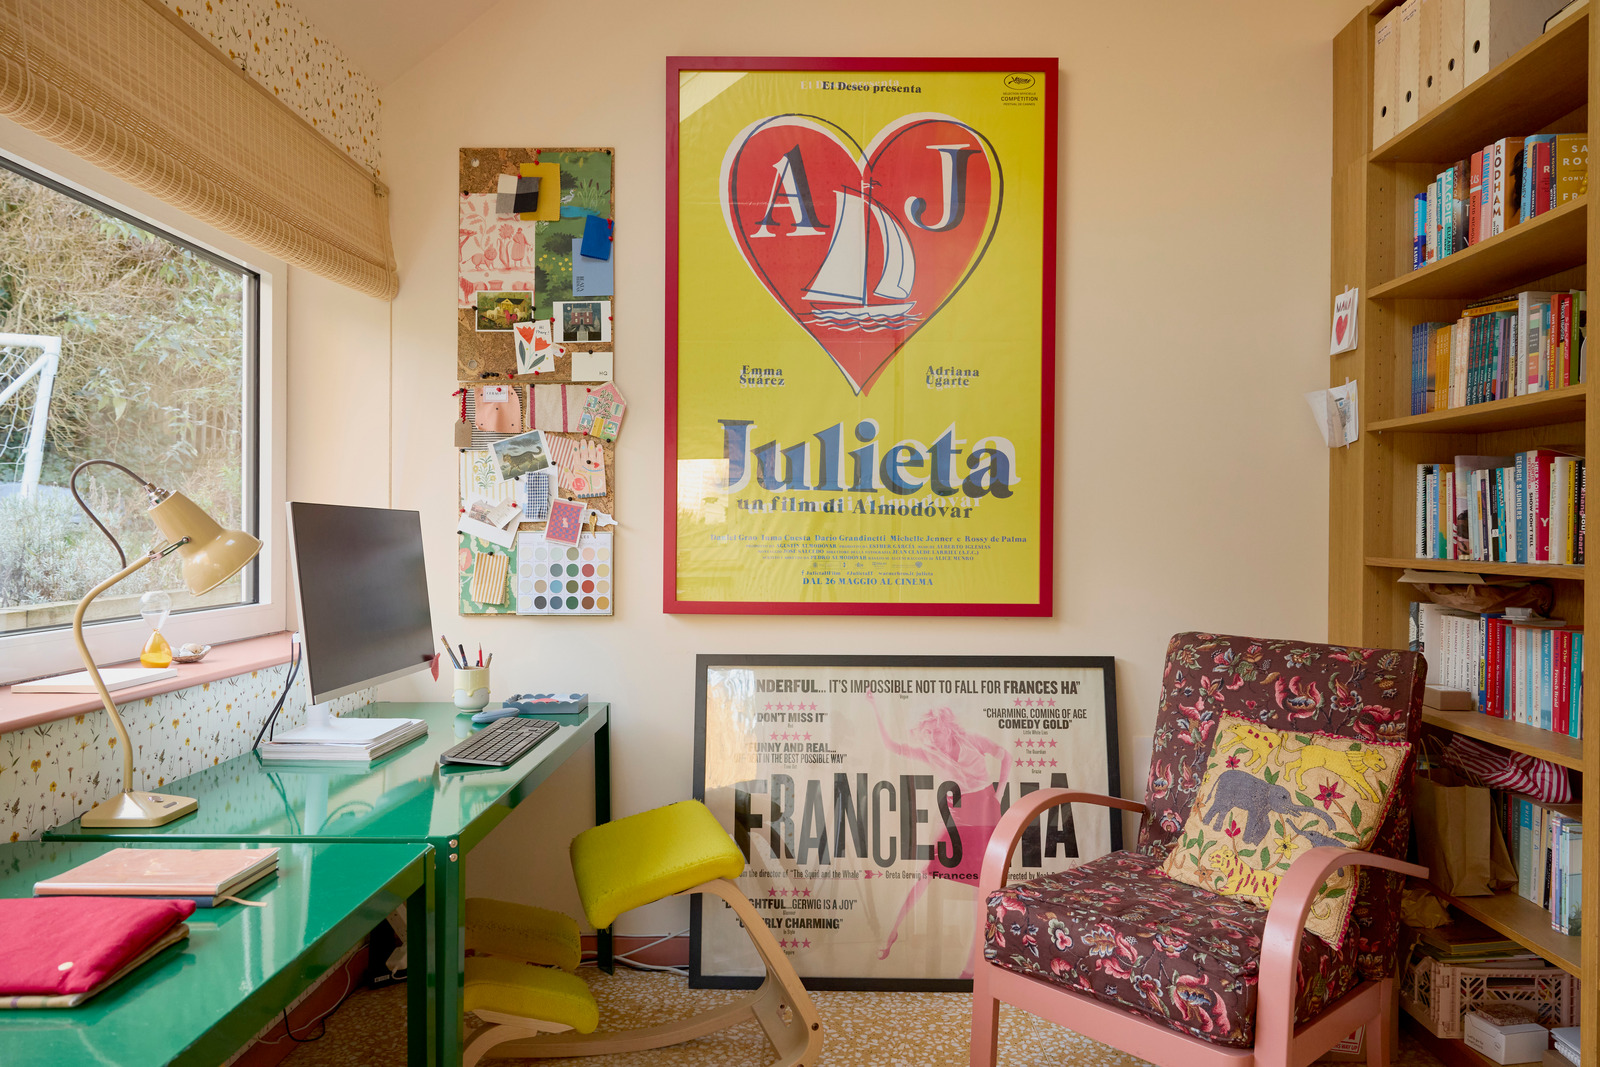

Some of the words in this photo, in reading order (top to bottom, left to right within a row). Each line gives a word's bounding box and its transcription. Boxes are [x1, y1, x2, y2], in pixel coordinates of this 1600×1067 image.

[822, 81, 834, 90] El
[838, 81, 870, 91] Deseo
[873, 84, 922, 94] presenta
[1493, 145, 1503, 218] RODHAM
[750, 144, 830, 238] A
[903, 143, 982, 233] J
[1444, 171, 1452, 224] MAGPIE
[741, 365, 783, 376] Emma
[925, 365, 980, 377] Adriana
[739, 374, 786, 386] Suárez
[925, 375, 970, 388] Ugarte
[717, 418, 1017, 499] Julieta
[737, 498, 763, 511] un
[771, 496, 817, 512] film
[823, 497, 844, 513] di
[852, 499, 973, 519] Almodóvar
[965, 535, 988, 543] Rossy
[829, 680, 848, 694] IT'S
[850, 680, 913, 694] IMPOSSIBLE
[915, 680, 936, 694] NOT
[938, 680, 952, 694] TO
[955, 680, 978, 694] FALL
[981, 680, 1001, 694] FOR
[1003, 680, 1058, 695] FRANCES
[1061, 681, 1081, 695] HA"
[788, 712, 813, 723] MISS
[983, 708, 1029, 719] "CHARMING,
[1030, 708, 1060, 719] COMING
[1061, 708, 1072, 719] OF
[1072, 708, 1087, 719] AGE
[998, 719, 1040, 730] COMEDY
[1042, 719, 1073, 730] GOLD"
[783, 742, 804, 753] AND
[771, 753, 783, 764] THE
[784, 753, 799, 764] BEST
[801, 753, 829, 764] POSSIBLE
[831, 753, 848, 764] WAY"
[735, 773, 963, 868] FRANCES
[758, 870, 782, 878] director
[804, 870, 820, 880] Squid
[832, 870, 842, 879] the
[885, 870, 900, 879] Greta
[902, 870, 921, 881] Gerwig
[1028, 871, 1035, 881] by
[823, 899, 831, 910] IS
[832, 900, 838, 910] A
[785, 918, 843, 929] CHARMING"
